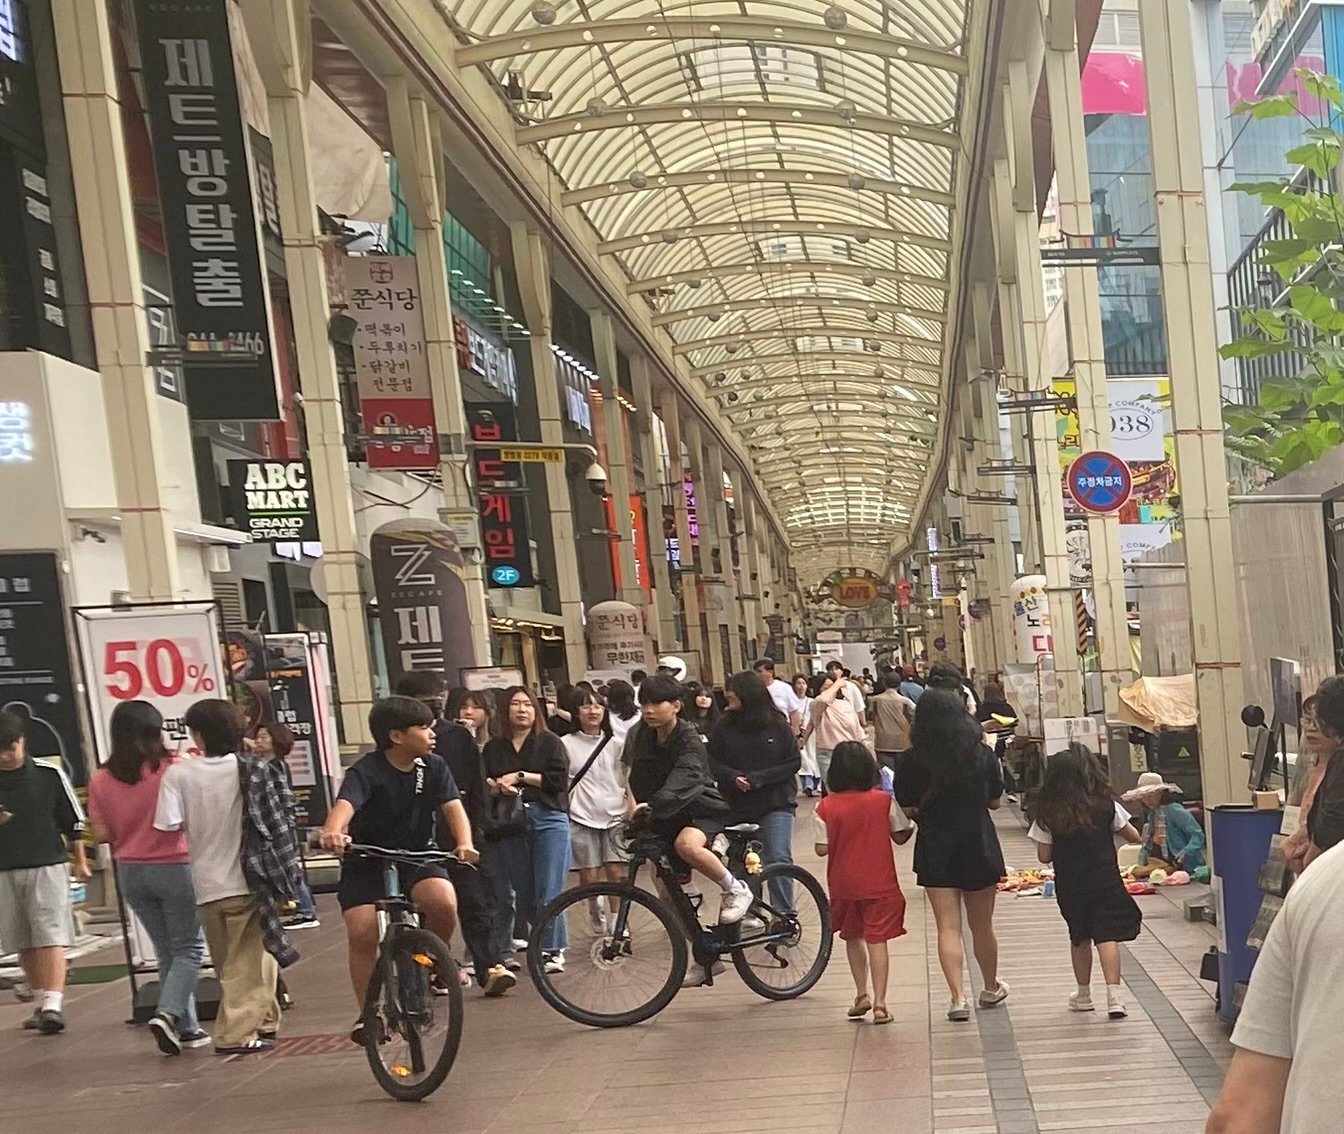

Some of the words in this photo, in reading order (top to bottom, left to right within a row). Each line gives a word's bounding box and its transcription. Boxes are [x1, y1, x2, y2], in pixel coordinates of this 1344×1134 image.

[158, 39, 243, 307] 제트방탈출
[364, 322, 406, 337] 떡볶이
[367, 341, 423, 355] 두루치기
[369, 360, 410, 374] 닭갈비
[372, 378, 413, 392] 전문점
[244, 463, 306, 490] ABC
[1077, 475, 1123, 487] 주정차금지
[245, 490, 309, 510] MART
[249, 518, 303, 528] GRAND
[250, 528, 300, 538] STAGE
[496, 569, 515, 581] 2F
[103, 638, 215, 699] 50%
